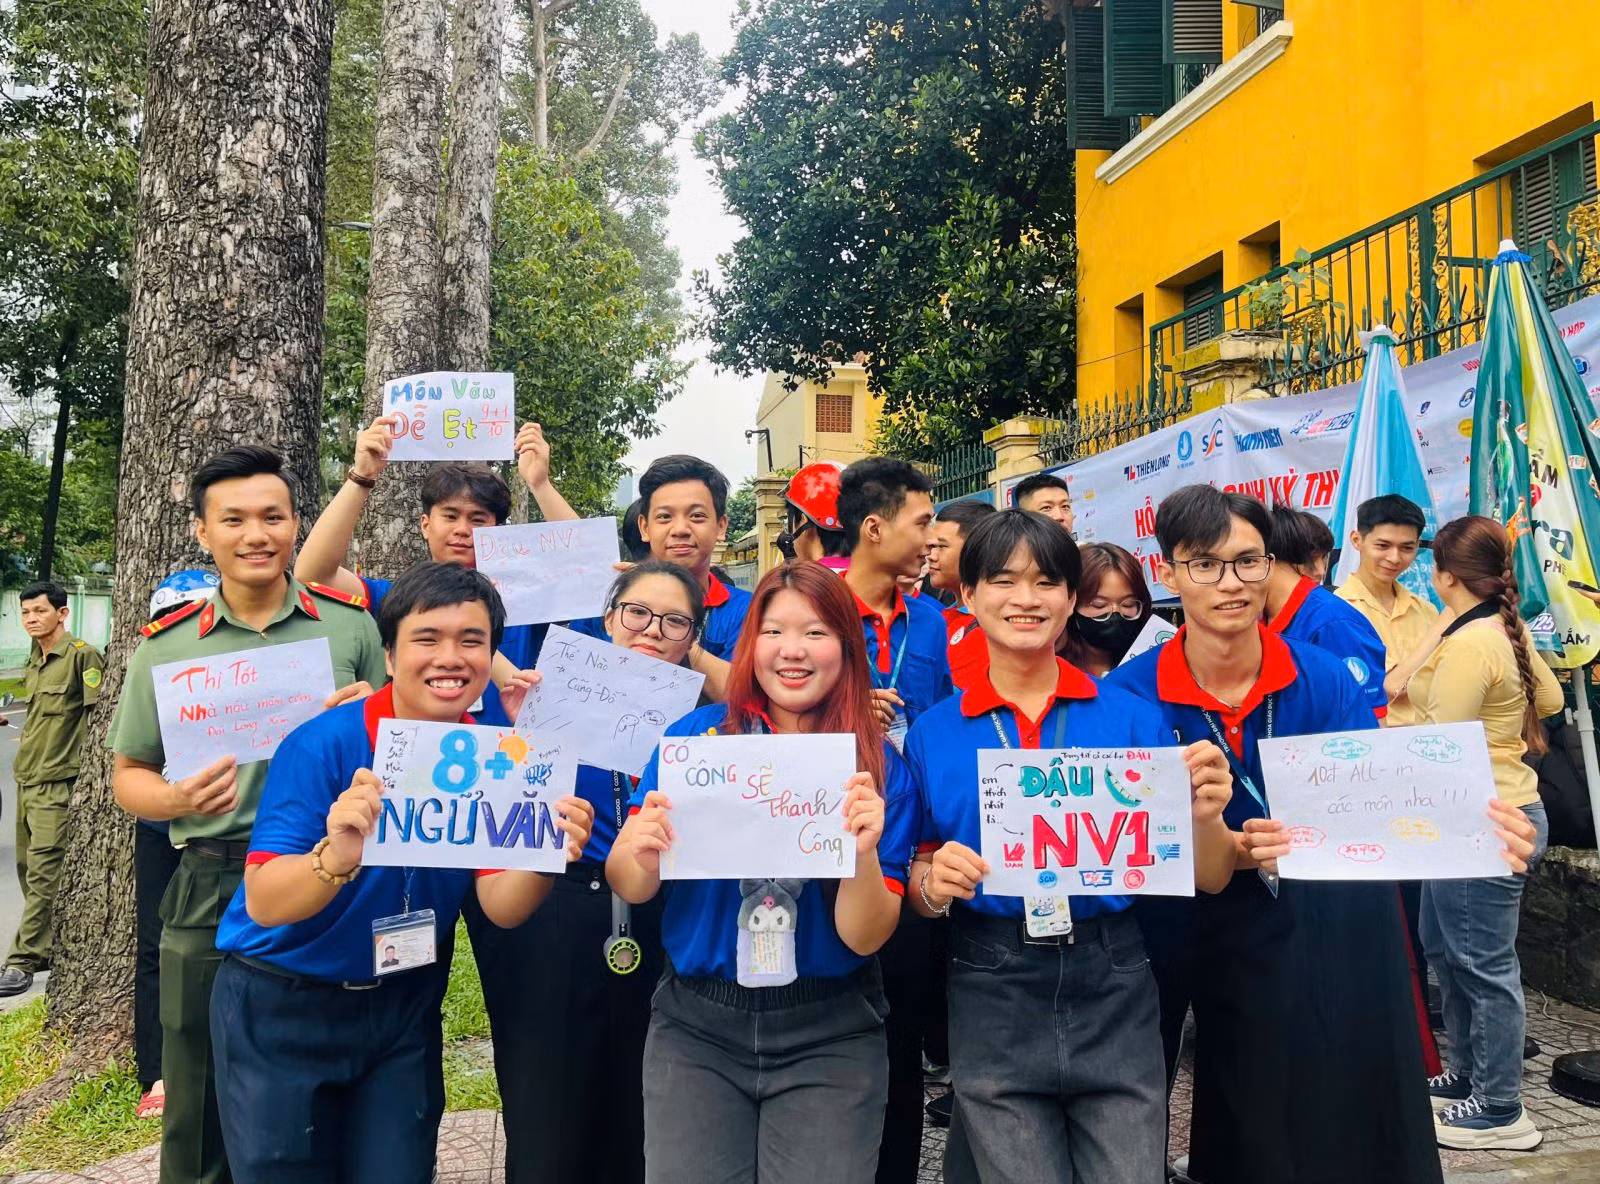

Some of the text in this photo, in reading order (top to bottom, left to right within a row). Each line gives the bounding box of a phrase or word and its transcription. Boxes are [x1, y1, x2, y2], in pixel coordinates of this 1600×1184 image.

[390, 378, 497, 405] Môn Văn
[389, 404, 478, 449] Dễ Ẹt
[488, 423, 503, 436] 10
[1558, 627, 1590, 645] LẮM
[585, 651, 609, 671] Nào
[171, 660, 259, 693] Thi Tốt
[180, 703, 218, 722] Nhà
[663, 738, 690, 764] CÓ
[685, 760, 737, 787] CÔNG
[742, 763, 774, 800] SẼ
[982, 777, 998, 785] em
[1017, 757, 1093, 808] ĐẬU
[1328, 794, 1352, 815] các
[1364, 794, 1395, 812] môn
[1404, 786, 1436, 808] nha
[481, 791, 567, 849] VĂN
[798, 821, 843, 867] Công
[1033, 811, 1155, 869] NV1
